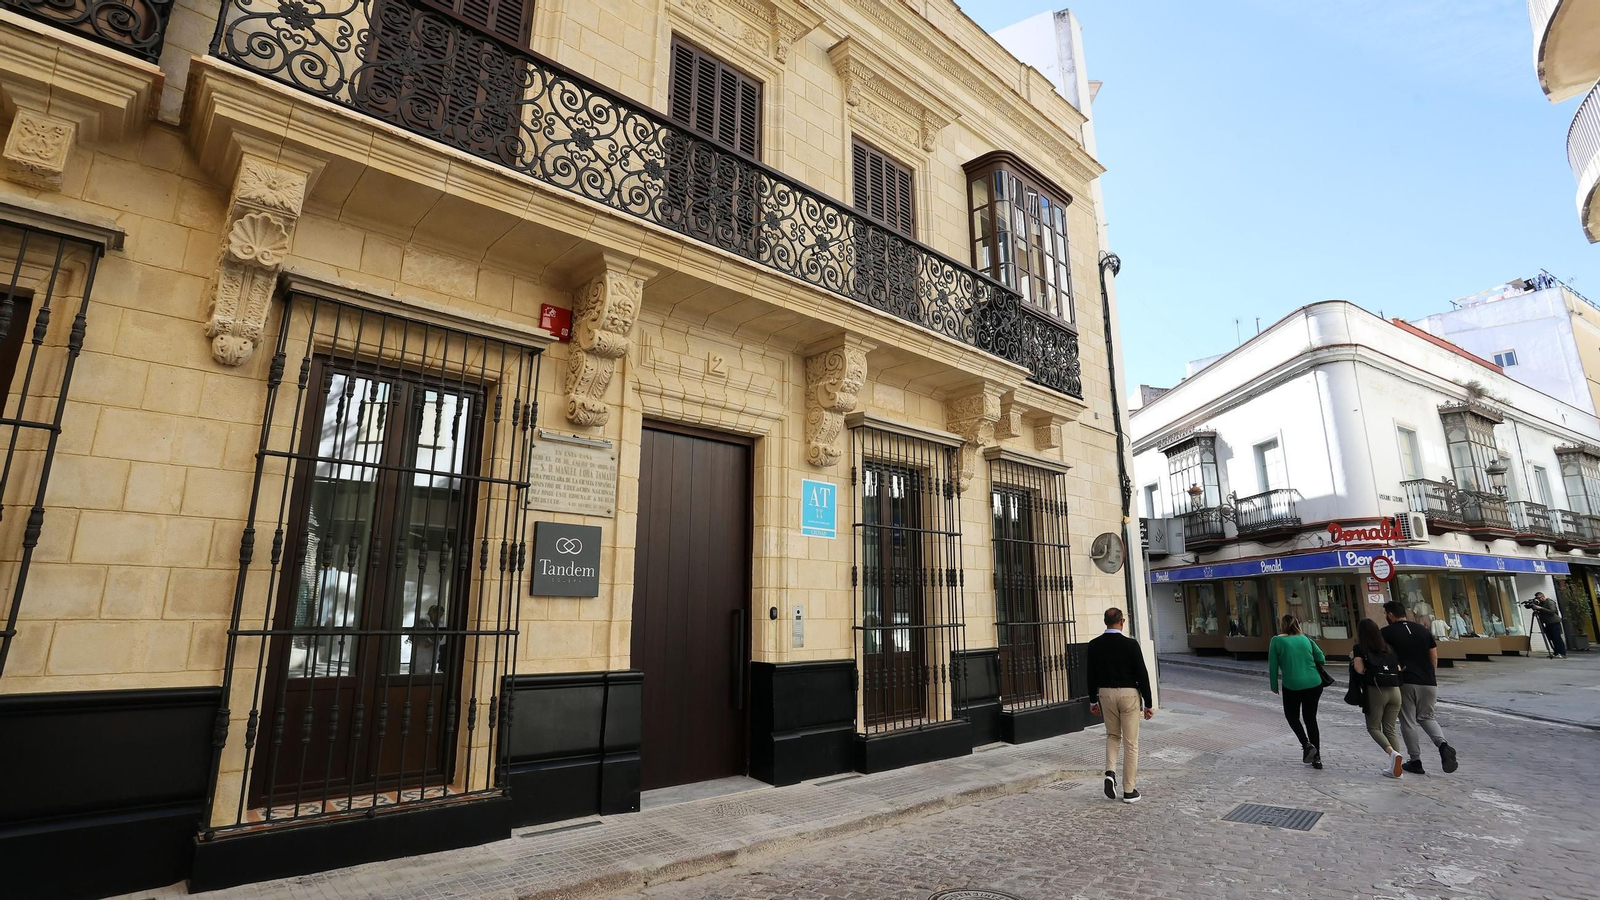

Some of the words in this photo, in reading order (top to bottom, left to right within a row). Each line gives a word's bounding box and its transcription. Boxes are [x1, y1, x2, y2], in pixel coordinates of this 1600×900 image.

[706, 351, 726, 377] 12
[555, 465, 577, 477] MANUEL
[579, 469, 594, 479] LORA
[596, 471, 616, 482] TAMAYO
[808, 485, 831, 508] AT
[1327, 517, 1405, 543] Donald
[539, 558, 595, 578] Tandem
[1260, 559, 1283, 574] Donald
